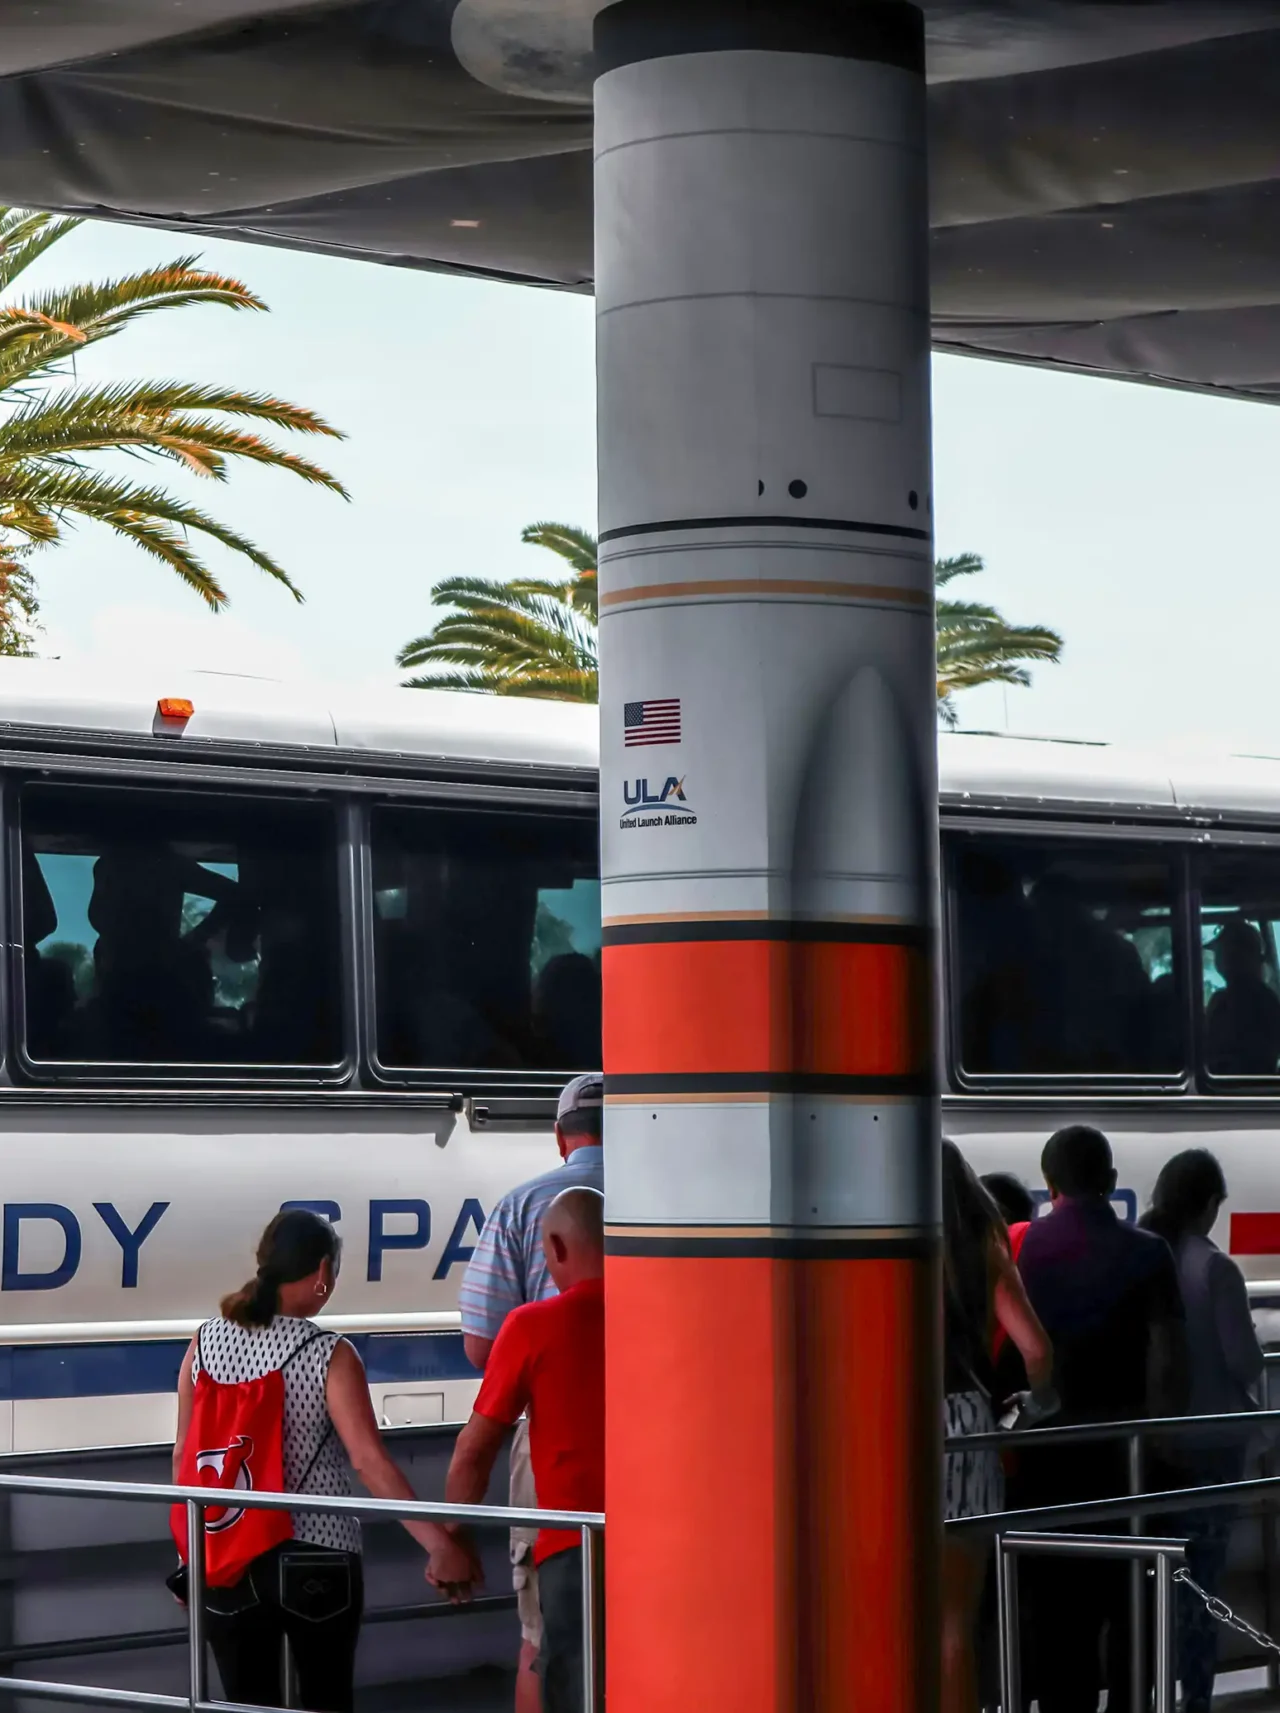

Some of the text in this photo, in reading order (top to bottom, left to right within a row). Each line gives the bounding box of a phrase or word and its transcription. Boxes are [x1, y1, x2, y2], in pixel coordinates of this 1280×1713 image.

[623, 776, 687, 805] ULA
[619, 814, 698, 829] United Launch Alliance
